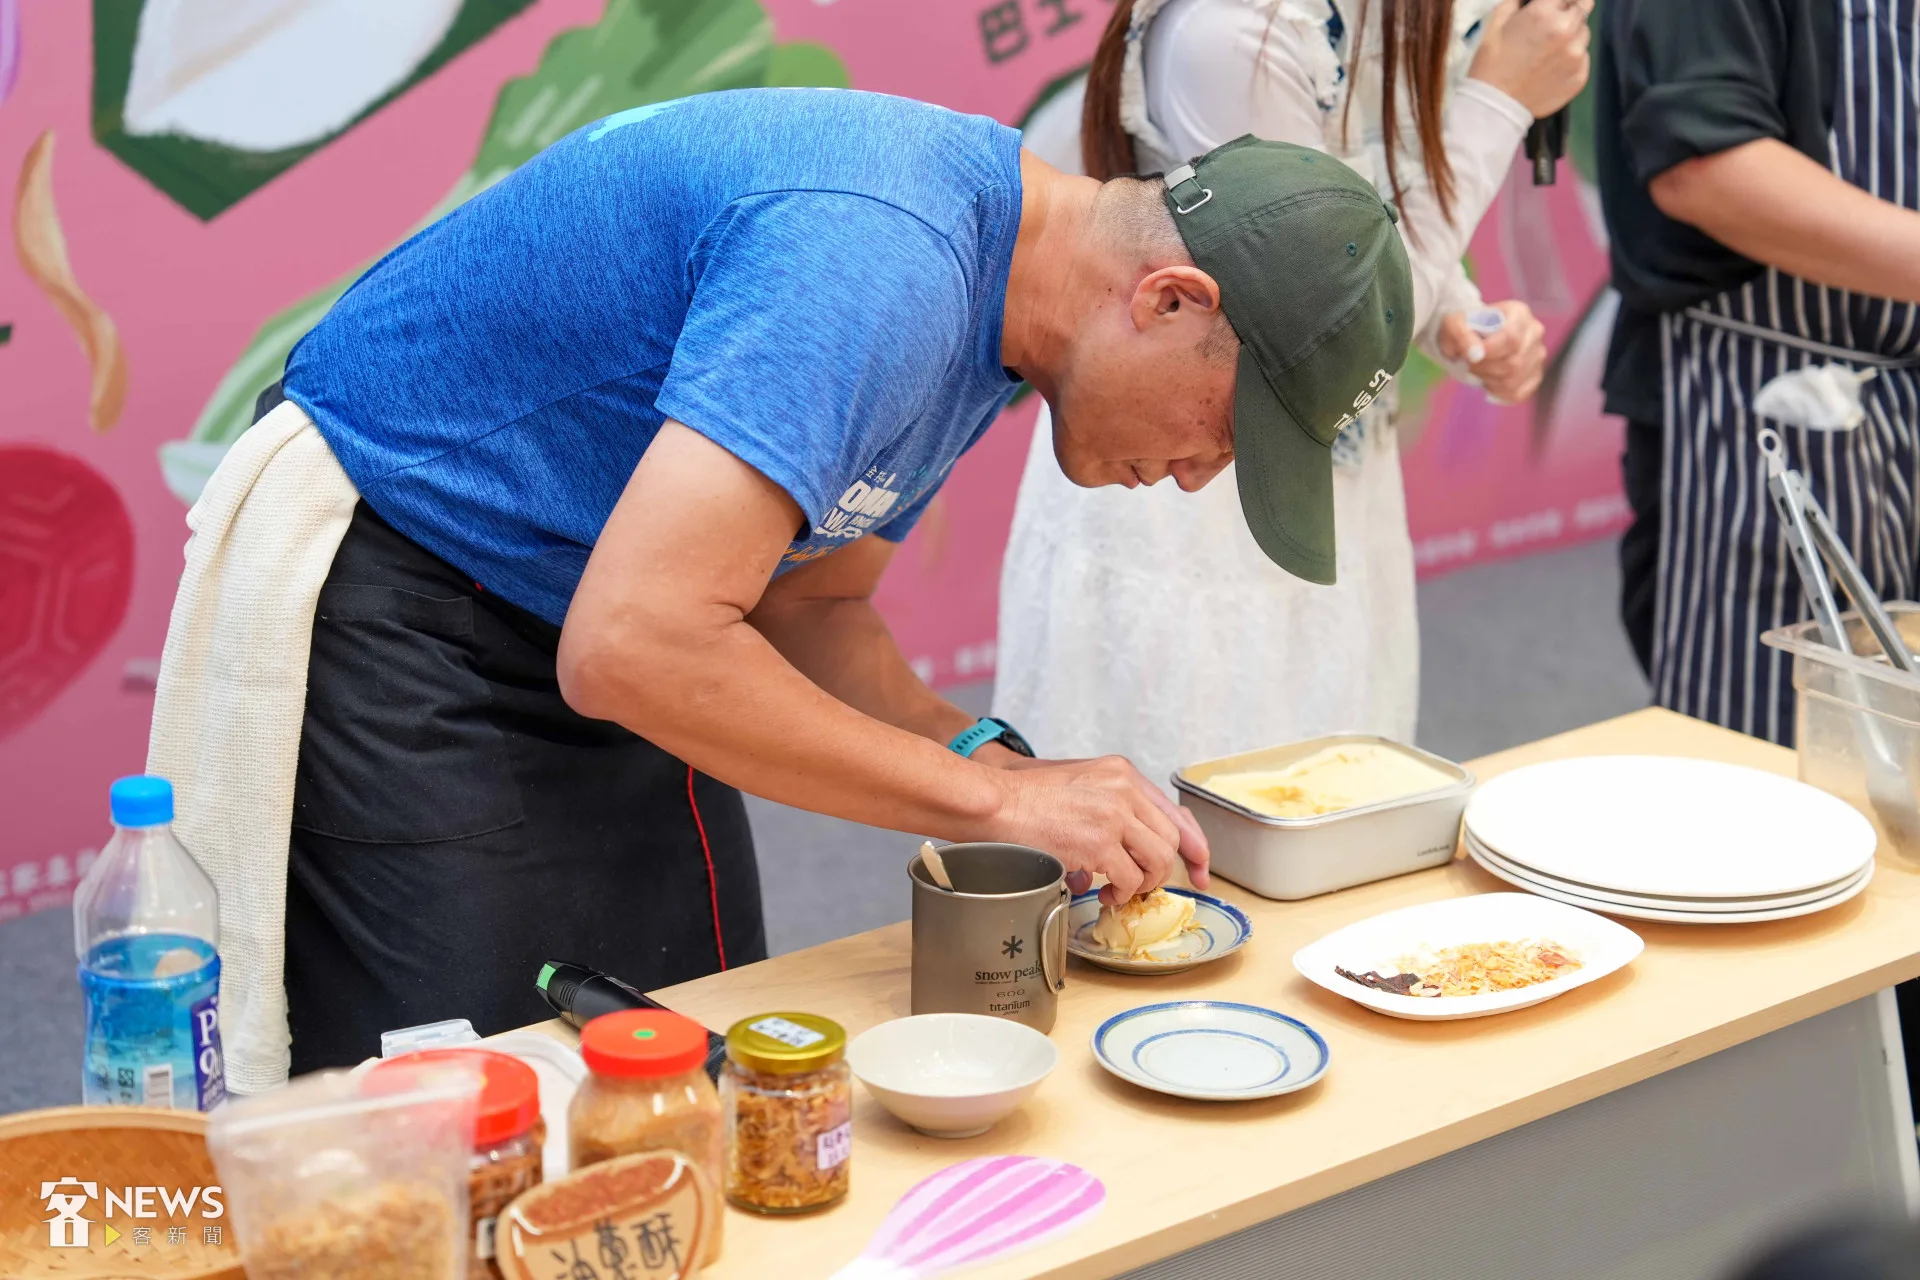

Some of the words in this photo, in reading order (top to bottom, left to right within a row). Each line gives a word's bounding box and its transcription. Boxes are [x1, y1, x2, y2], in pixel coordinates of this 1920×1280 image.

[975, 971, 1011, 980] snow
[1014, 960, 1042, 982] peak
[996, 989, 1025, 997] 600
[989, 1000, 1031, 1011] titanium
